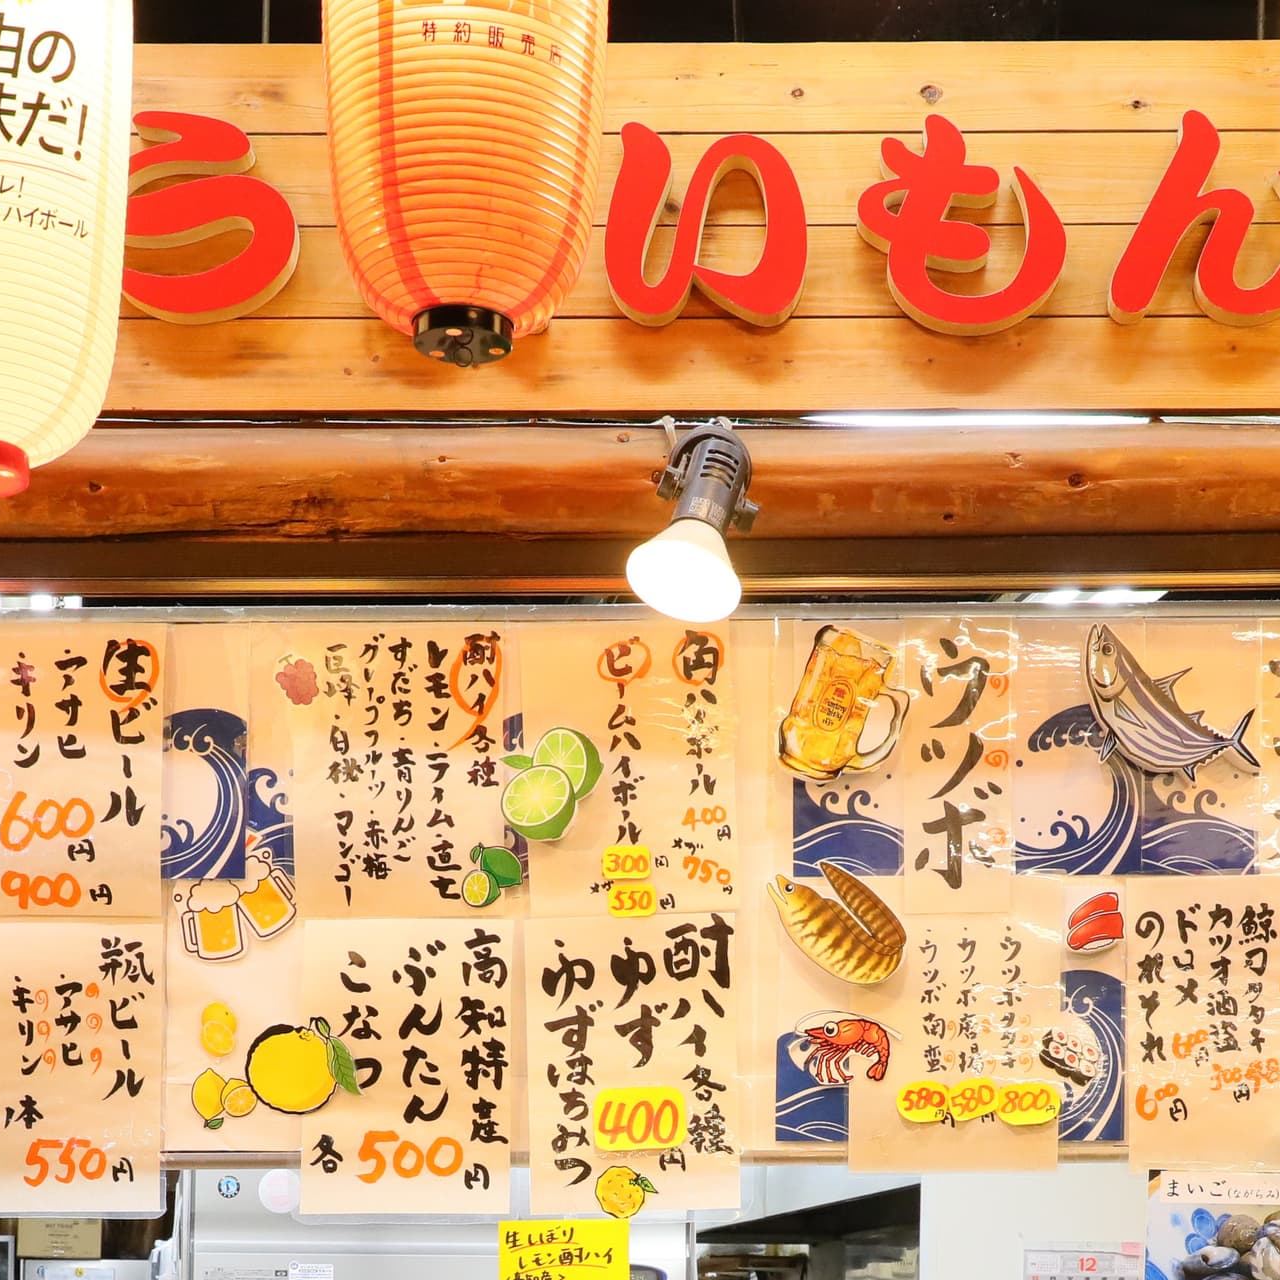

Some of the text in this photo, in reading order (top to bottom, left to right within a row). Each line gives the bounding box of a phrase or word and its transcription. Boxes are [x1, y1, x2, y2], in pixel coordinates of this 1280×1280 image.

[422, 18, 562, 66] 特約販売店
[100, 638, 158, 827] 生ビール
[463, 631, 501, 788] 酎ハイ各種
[605, 635, 643, 846] ビームハイボール
[915, 637, 1002, 890] ウツボ
[98, 936, 155, 1101] 瓶ビール
[340, 950, 384, 1091] こなつ
[1135, 911, 1167, 1065] のれそれ
[1173, 903, 1201, 1007] ドロメ
[1207, 904, 1239, 1053] カツオ酒盗
[392, 939, 448, 1125] ぶんたん
[455, 928, 509, 1145] 高知特産
[663, 913, 734, 1156] 酎ハイ各種
[23, 1137, 134, 1188] 550円
[310, 1134, 343, 1174] 各
[1166, 1177, 1226, 1199] まいご
[506, 1226, 576, 1248] 生しぼり
[518, 1247, 614, 1271] レモン酎ハイ
[1079, 1258, 1096, 1272] 12
